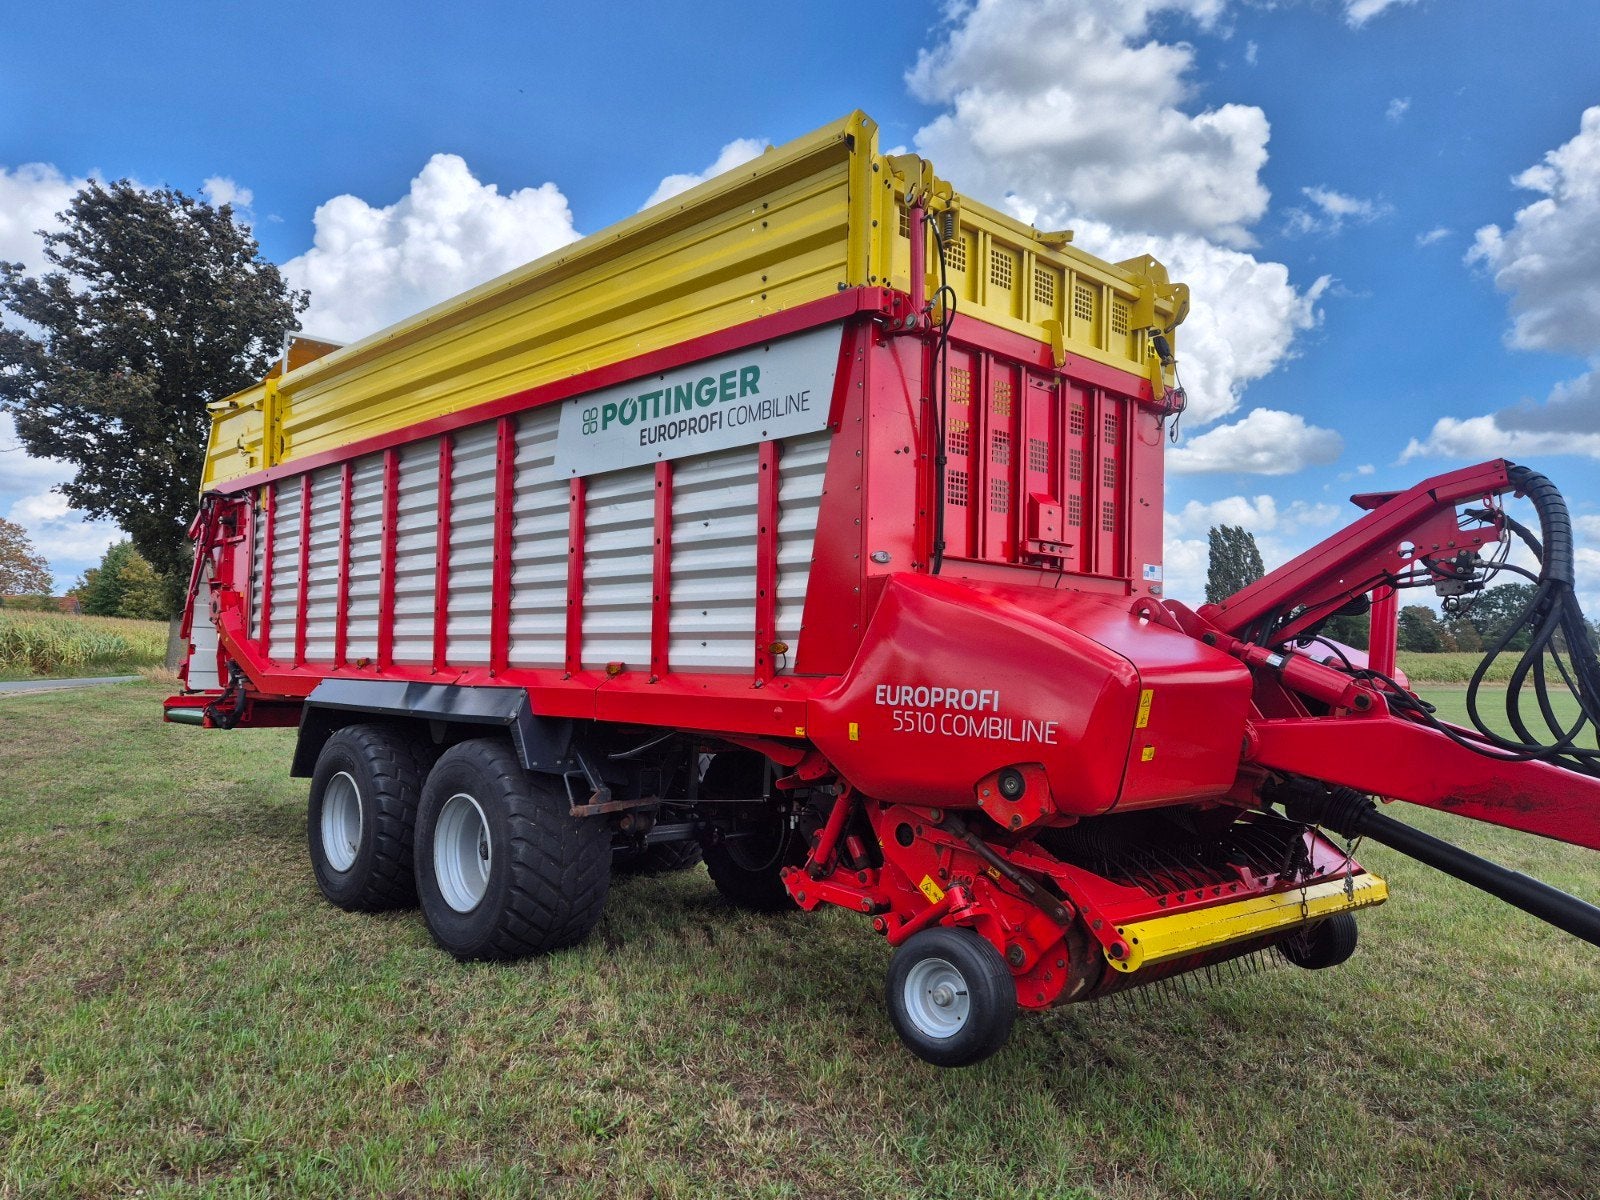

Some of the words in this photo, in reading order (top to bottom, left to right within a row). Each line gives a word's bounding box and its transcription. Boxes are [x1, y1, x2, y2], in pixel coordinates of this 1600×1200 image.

[602, 365, 760, 430] PÖTTINGER
[640, 411, 722, 446] EUROPROFI
[728, 390, 810, 427] COMBILINE
[875, 684, 999, 712] EUROPROFI
[893, 710, 936, 733] 5510
[940, 713, 1058, 744] COMBILINE
